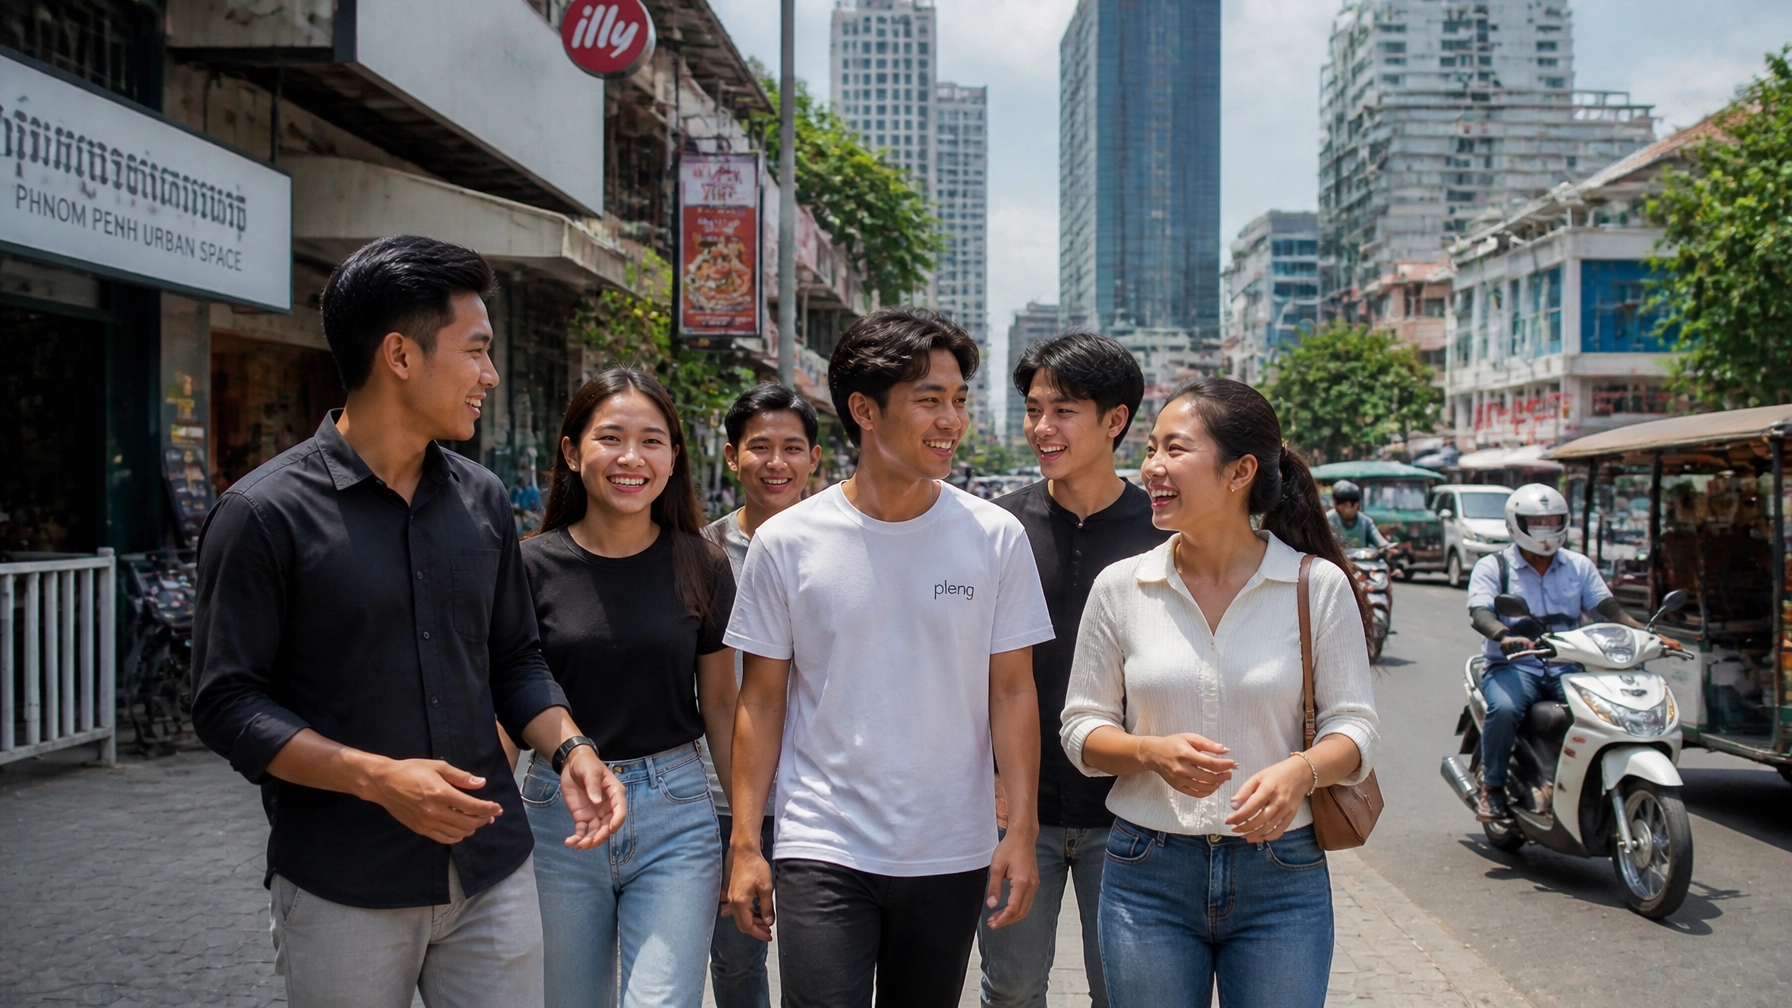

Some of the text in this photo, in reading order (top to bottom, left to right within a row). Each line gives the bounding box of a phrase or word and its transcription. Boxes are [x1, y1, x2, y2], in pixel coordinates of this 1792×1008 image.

[571, 4, 639, 58] illy
[15, 184, 243, 272] PHNOM PENH URBAN SPACE
[934, 580, 974, 600] pleng
